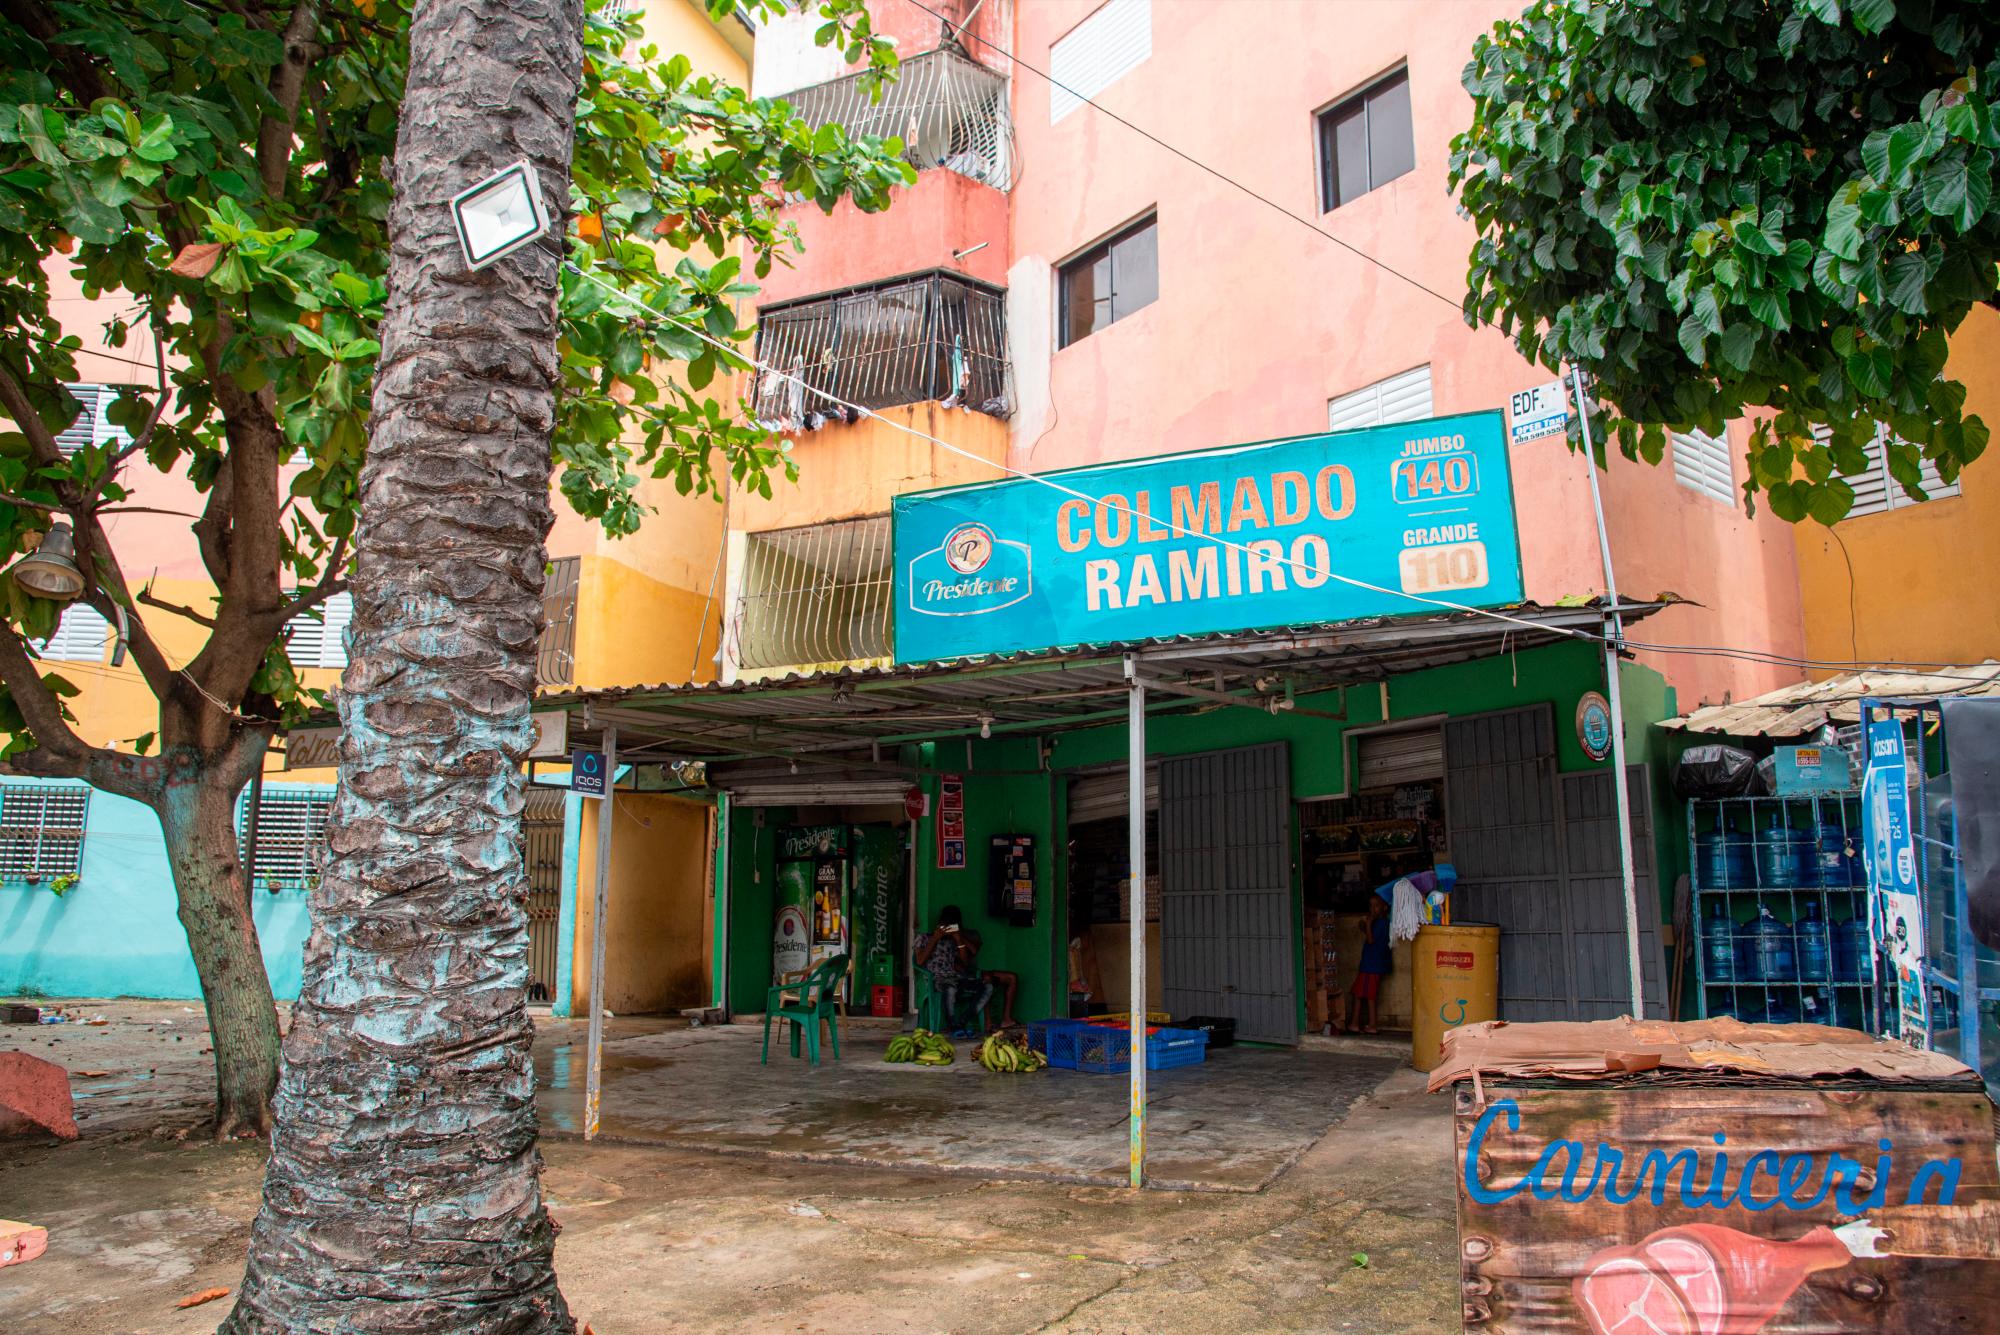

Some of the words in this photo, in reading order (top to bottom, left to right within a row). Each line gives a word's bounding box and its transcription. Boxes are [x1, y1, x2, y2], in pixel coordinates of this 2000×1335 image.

[1400, 434, 1465, 457] JUMBO
[1399, 457, 1471, 498] 140
[1056, 464, 1357, 553] COLMADO
[1403, 522, 1479, 547] GRANDE
[1085, 533, 1332, 612] RAMIRO
[1407, 547, 1479, 590] 110
[922, 576, 1018, 602] Presidente
[1873, 730, 1899, 757] dasani
[575, 775, 602, 787] IQOS
[785, 827, 836, 856] Presidente
[1464, 1098, 1962, 1216] Carniceria
